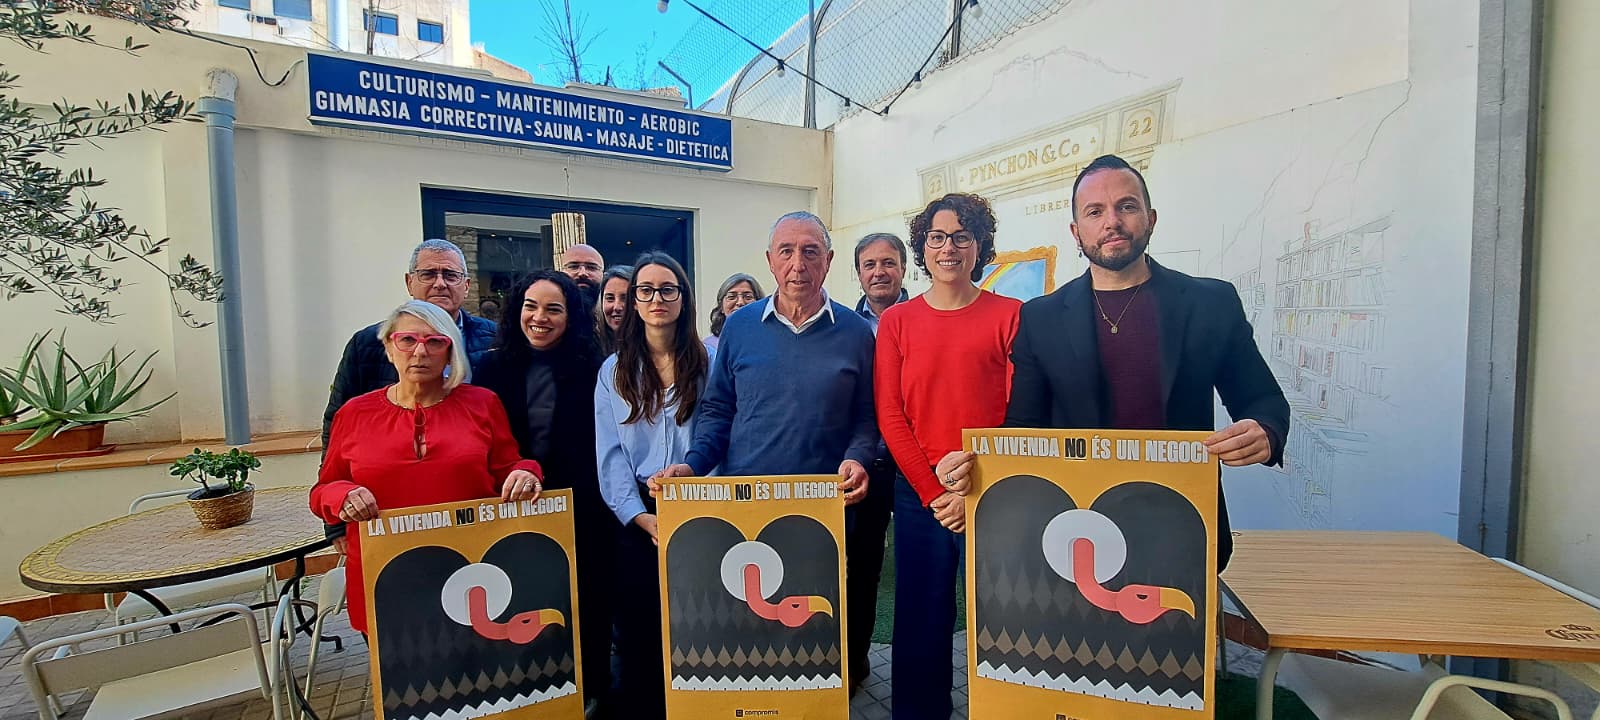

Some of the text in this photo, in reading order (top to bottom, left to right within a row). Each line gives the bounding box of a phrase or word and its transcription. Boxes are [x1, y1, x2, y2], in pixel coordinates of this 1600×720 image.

[359, 70, 475, 104] CULTURISMO
[496, 90, 624, 125] MANTENIMIENTO
[640, 112, 700, 137] AEROBIC
[315, 90, 411, 121] GIMNASIA
[596, 128, 655, 151] MASAJE
[666, 139, 729, 161] DIETETICA
[1128, 116, 1152, 138] 22
[1025, 198, 1071, 216] LIBRER
[971, 435, 1209, 464] LA VIVENDA NO ÉS UN NEGOCI
[662, 480, 838, 501] LA VIVENDA NO ÉS UN NEGOCI
[367, 495, 567, 537] LA VIVENDA NO ÉS UN NEGOCI
[1544, 629, 1600, 642] Cor
